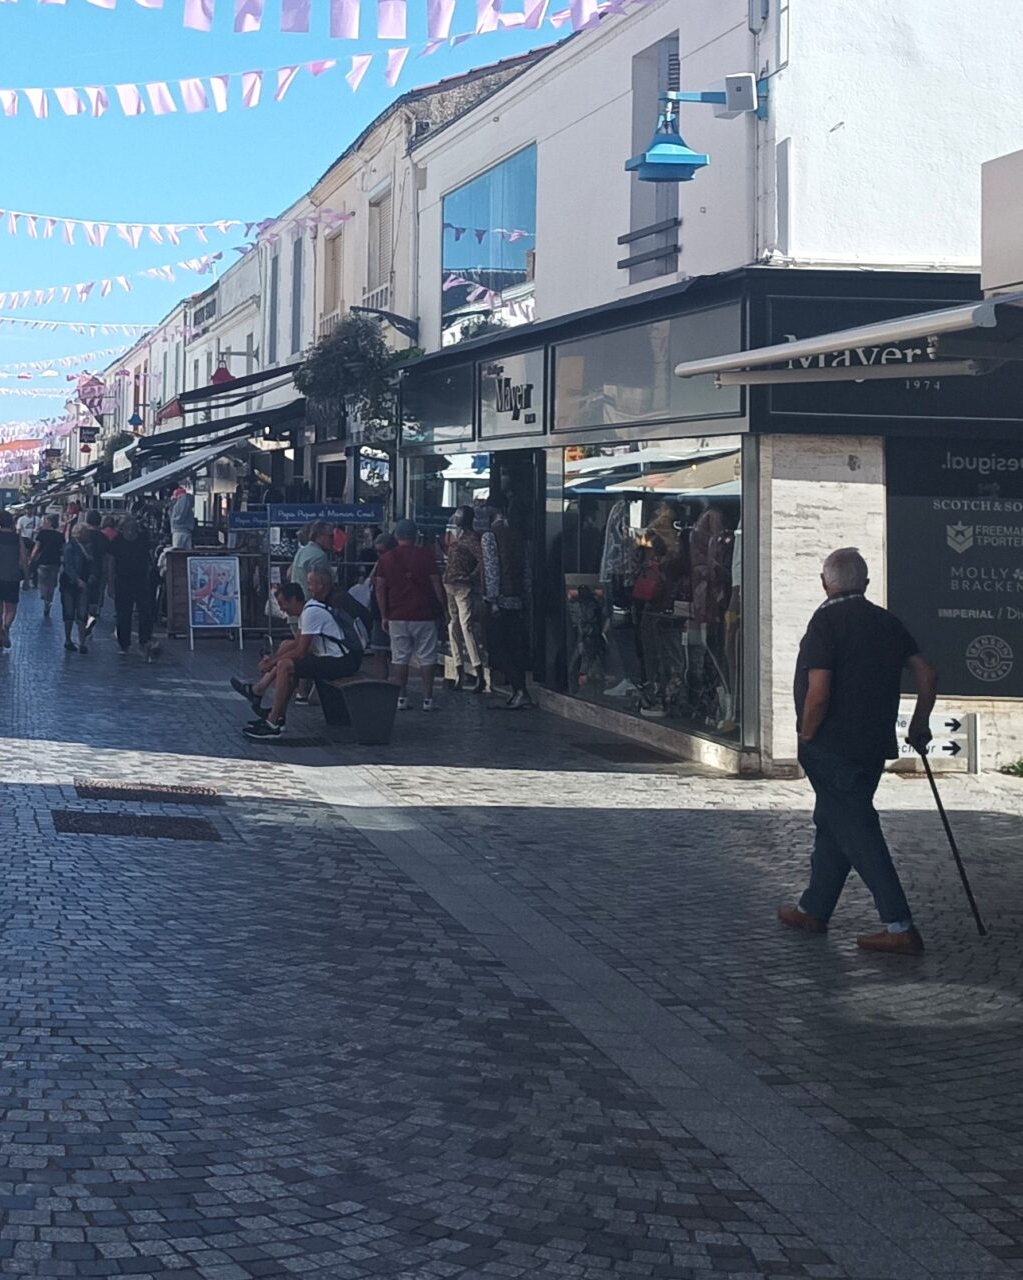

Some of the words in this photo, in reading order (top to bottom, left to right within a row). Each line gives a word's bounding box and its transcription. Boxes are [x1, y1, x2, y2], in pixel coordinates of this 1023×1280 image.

[905, 380, 941, 390] 1974
[975, 525, 1023, 536] FREEMA
[950, 566, 1009, 579] MOLLY
[938, 608, 995, 619] IMPERIAL
